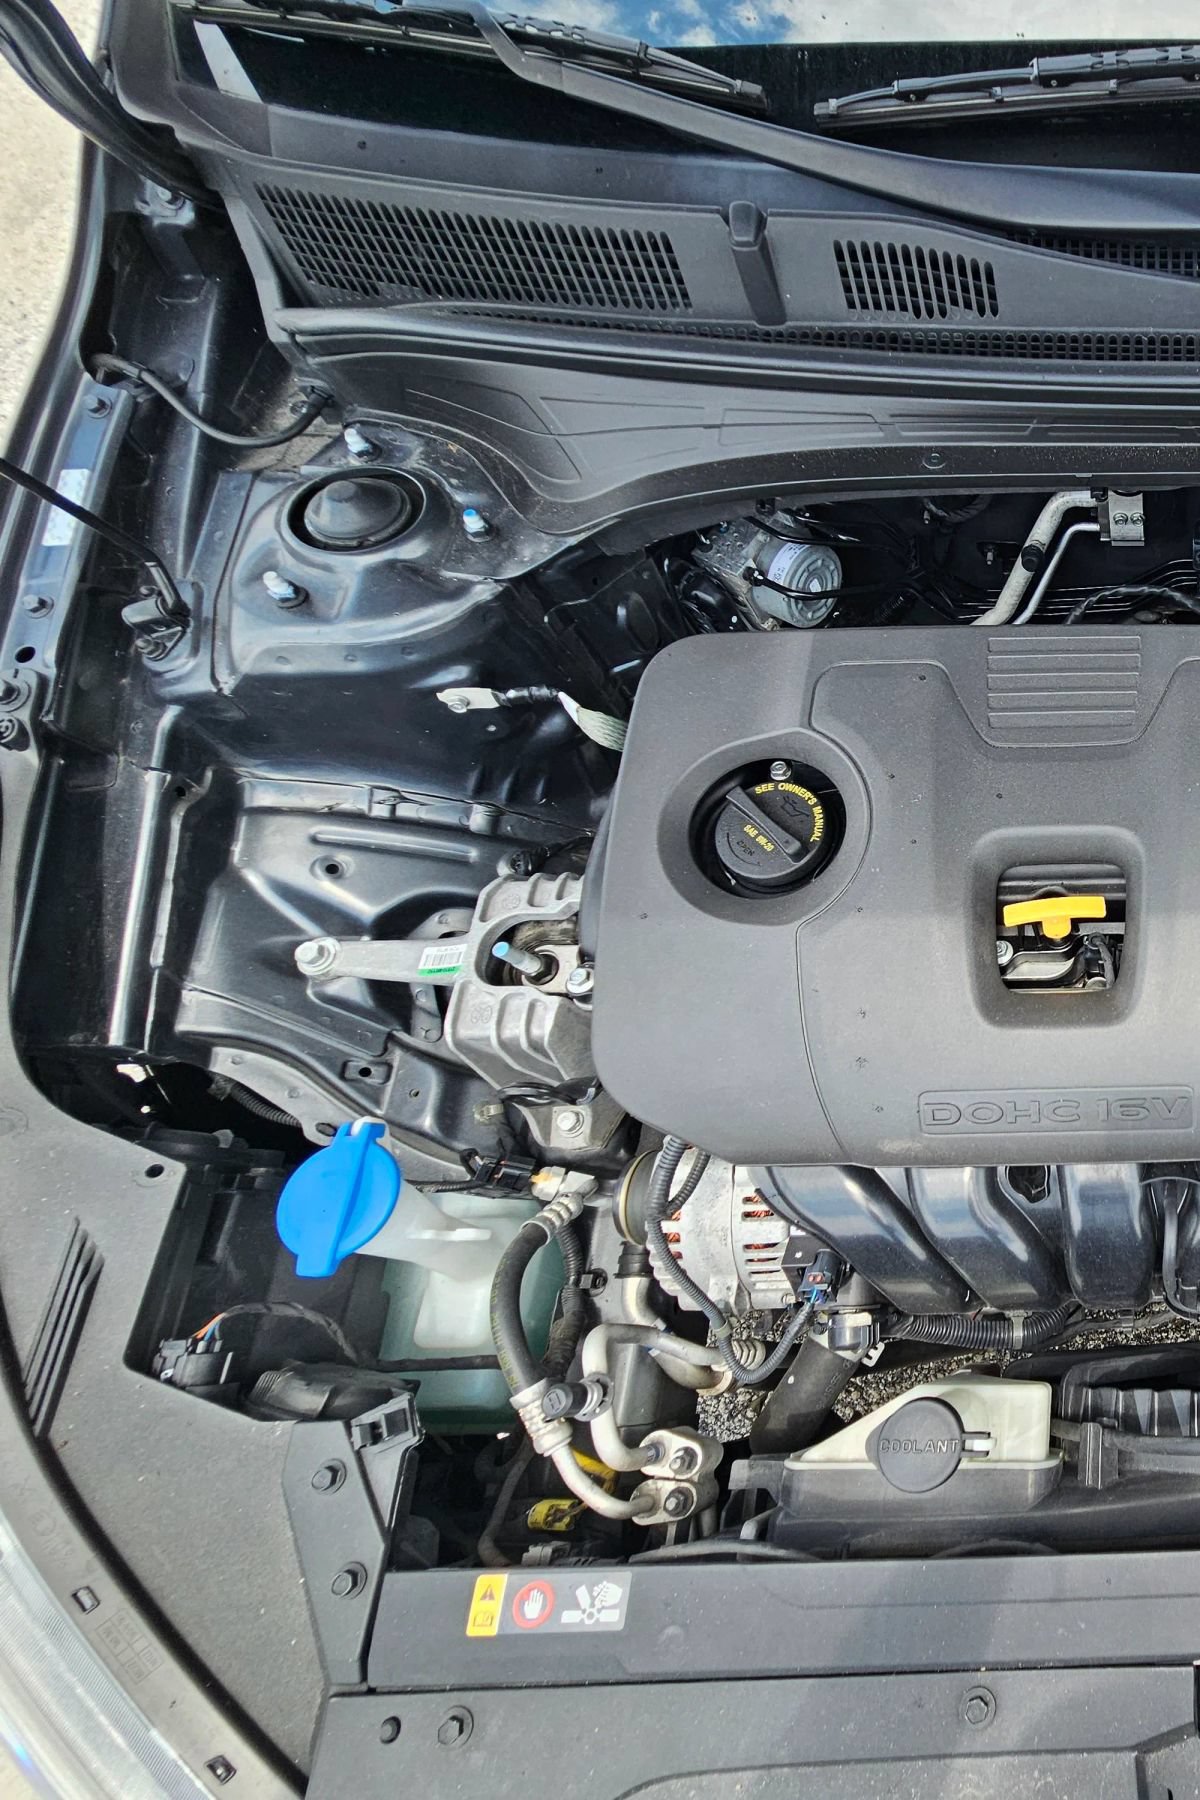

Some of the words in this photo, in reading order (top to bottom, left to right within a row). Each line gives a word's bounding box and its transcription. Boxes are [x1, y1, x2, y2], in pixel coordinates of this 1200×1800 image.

[754, 782, 775, 795] SEE
[777, 782, 818, 805] OWNER'S
[811, 806, 825, 843] MANUAL
[743, 824, 757, 838] SAE
[923, 1099, 1081, 1126] DOHC
[1096, 1095, 1190, 1122] 16V
[880, 1438, 960, 1454] COOLANT
